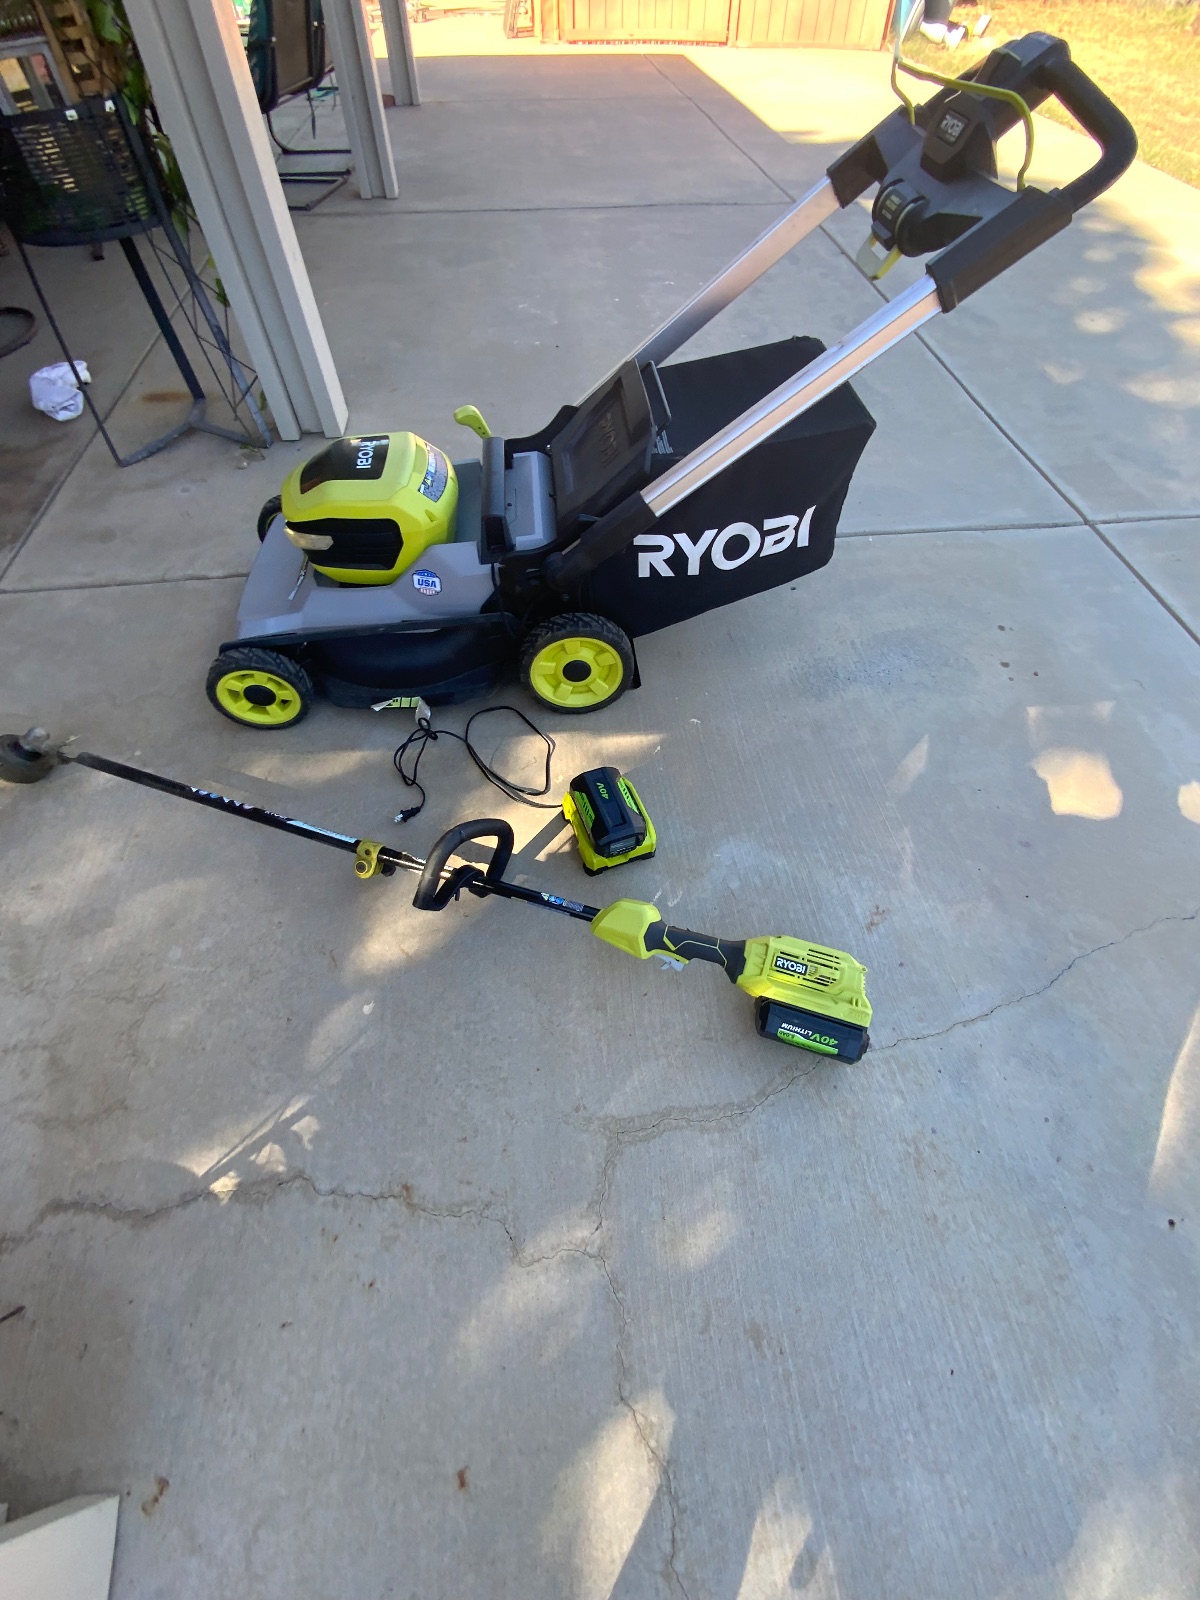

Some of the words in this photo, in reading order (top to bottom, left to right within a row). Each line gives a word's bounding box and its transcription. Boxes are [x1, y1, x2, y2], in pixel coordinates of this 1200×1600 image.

[356, 441, 376, 468] RYOBI
[633, 504, 816, 577] RYOBI
[418, 578, 437, 588] USA
[776, 957, 806, 974] RYOBI
[781, 1022, 812, 1037] LITHIUM
[809, 1033, 839, 1046] 40V
